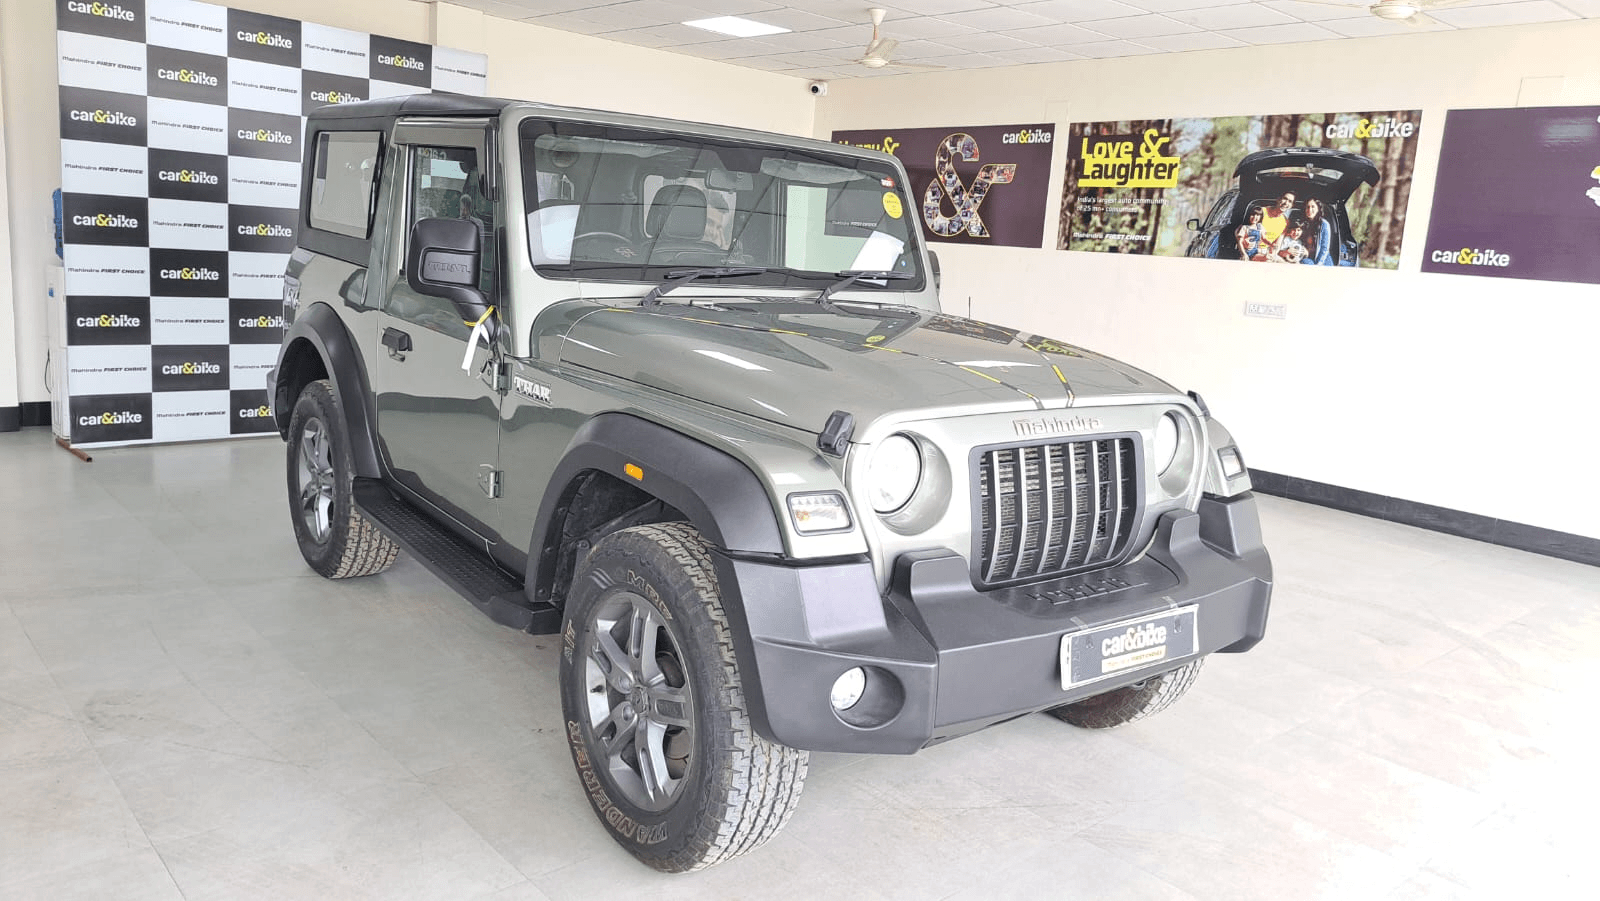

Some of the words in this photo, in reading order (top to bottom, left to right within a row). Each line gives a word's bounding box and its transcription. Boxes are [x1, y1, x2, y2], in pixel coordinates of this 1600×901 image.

[68, 0, 135, 21] car&bike
[237, 30, 292, 49] car&bike
[377, 54, 424, 71] car&bike
[157, 68, 218, 86] car&bike
[70, 109, 136, 126] car&bike
[237, 128, 292, 145] car&bike
[1002, 129, 1051, 144] car&bike
[1325, 118, 1414, 139] car&bike
[1081, 137, 1134, 159] Love
[1140, 128, 1170, 158] &
[158, 169, 218, 185] car&bike
[1080, 158, 1178, 186] Laughter
[73, 214, 138, 228] car&bike
[237, 223, 292, 237] car&bike
[1431, 247, 1510, 267] car&bike
[160, 267, 219, 281] car&bike
[76, 315, 140, 328] car&bike
[239, 315, 283, 328] car&bik
[162, 362, 220, 375] car&bike
[514, 376, 552, 402] THAR
[79, 412, 142, 426] car&bike
[1012, 415, 1103, 437] Mahindra
[627, 569, 673, 621] MRF
[1102, 623, 1167, 657] car&bike
[567, 719, 668, 845] WANDERER
